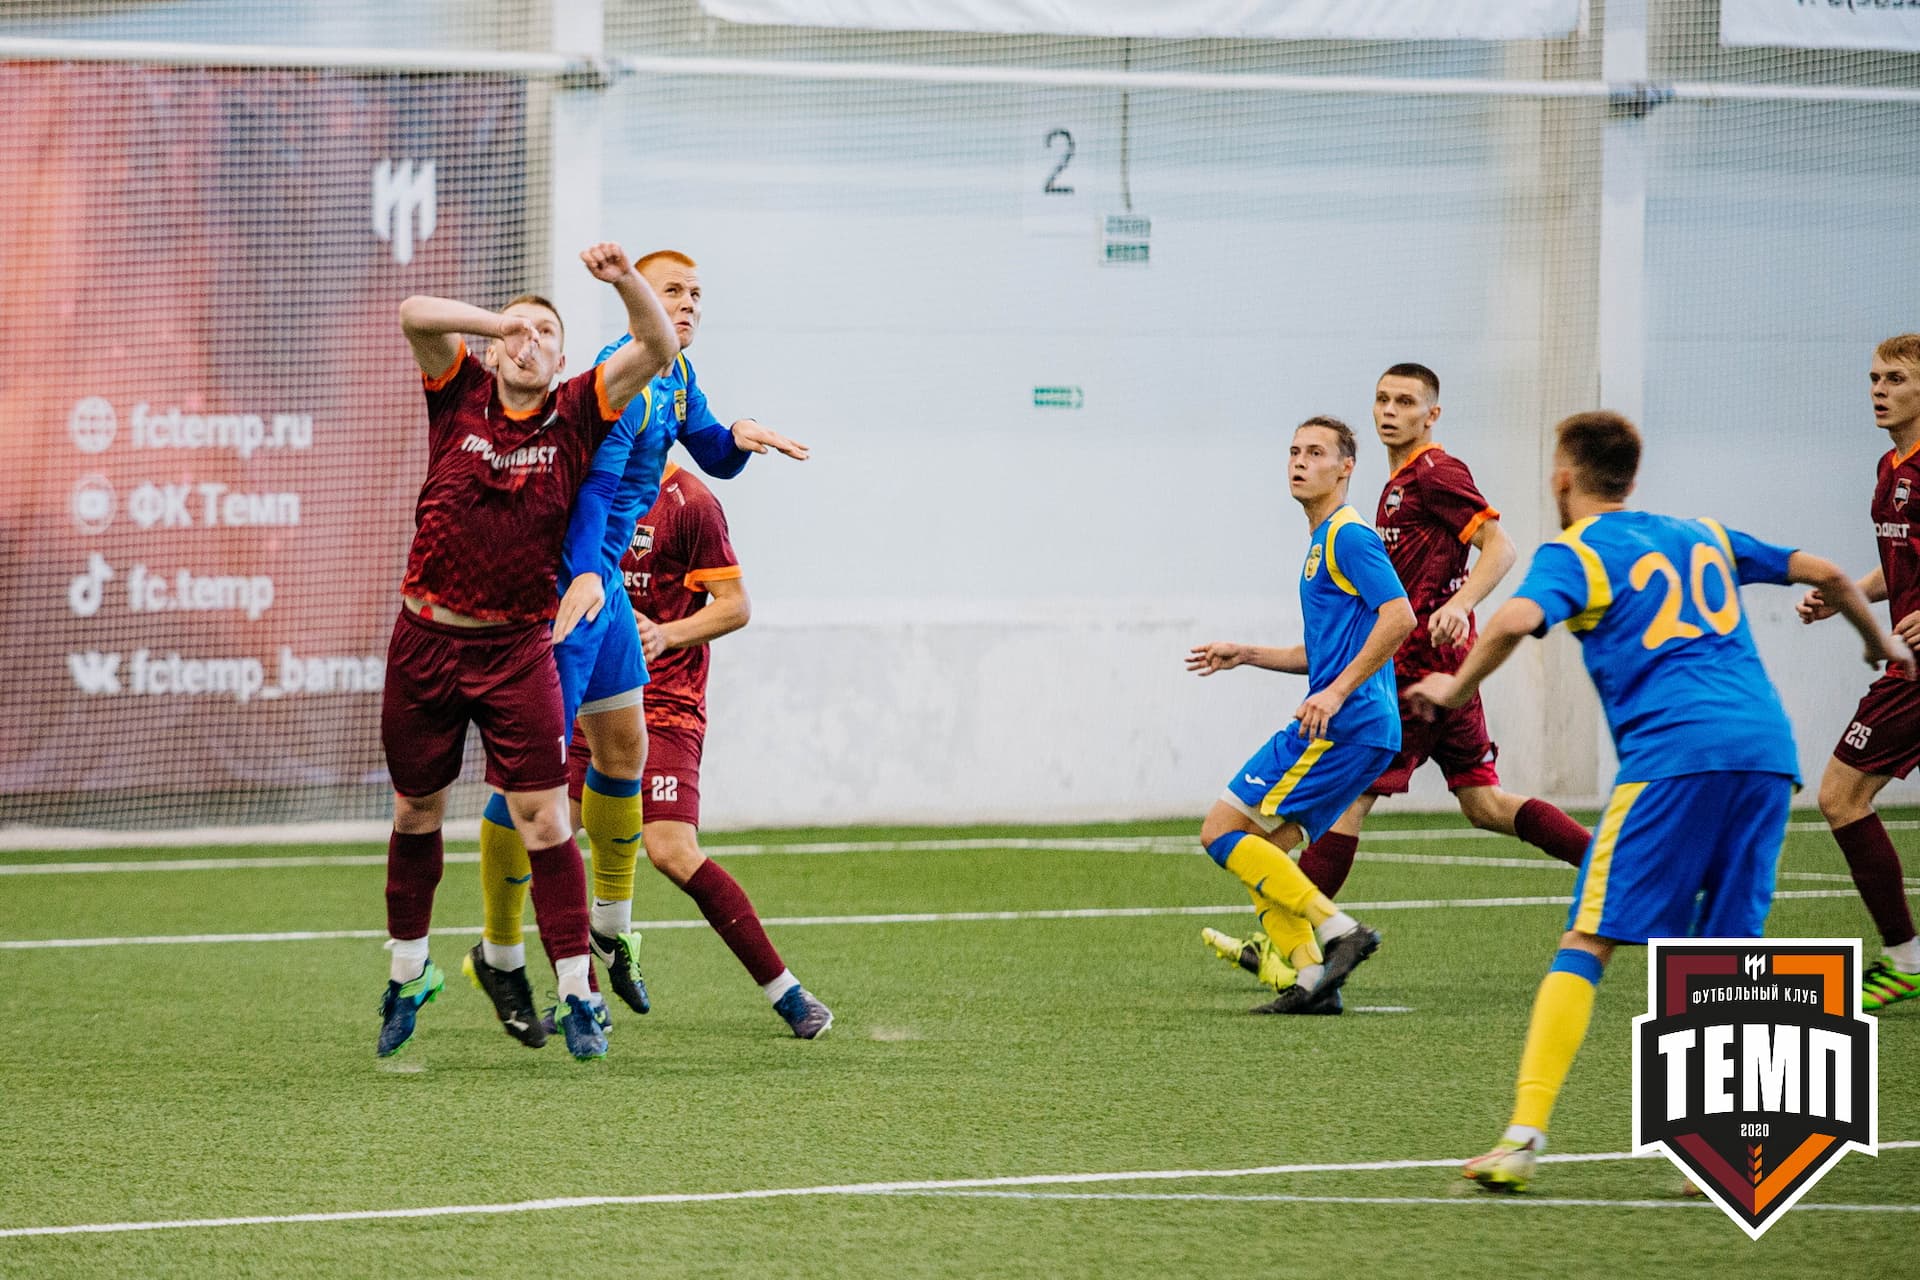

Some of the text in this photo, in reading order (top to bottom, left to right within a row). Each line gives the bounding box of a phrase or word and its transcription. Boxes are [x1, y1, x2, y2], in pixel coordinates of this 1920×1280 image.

[1043, 128, 1076, 194] 2
[130, 404, 314, 458] fctemp.ru
[129, 482, 300, 528] ФК Темп
[128, 562, 275, 620] fc.temp
[1629, 542, 1741, 650] 20
[1844, 721, 1873, 751] 25
[651, 775, 678, 802] 22
